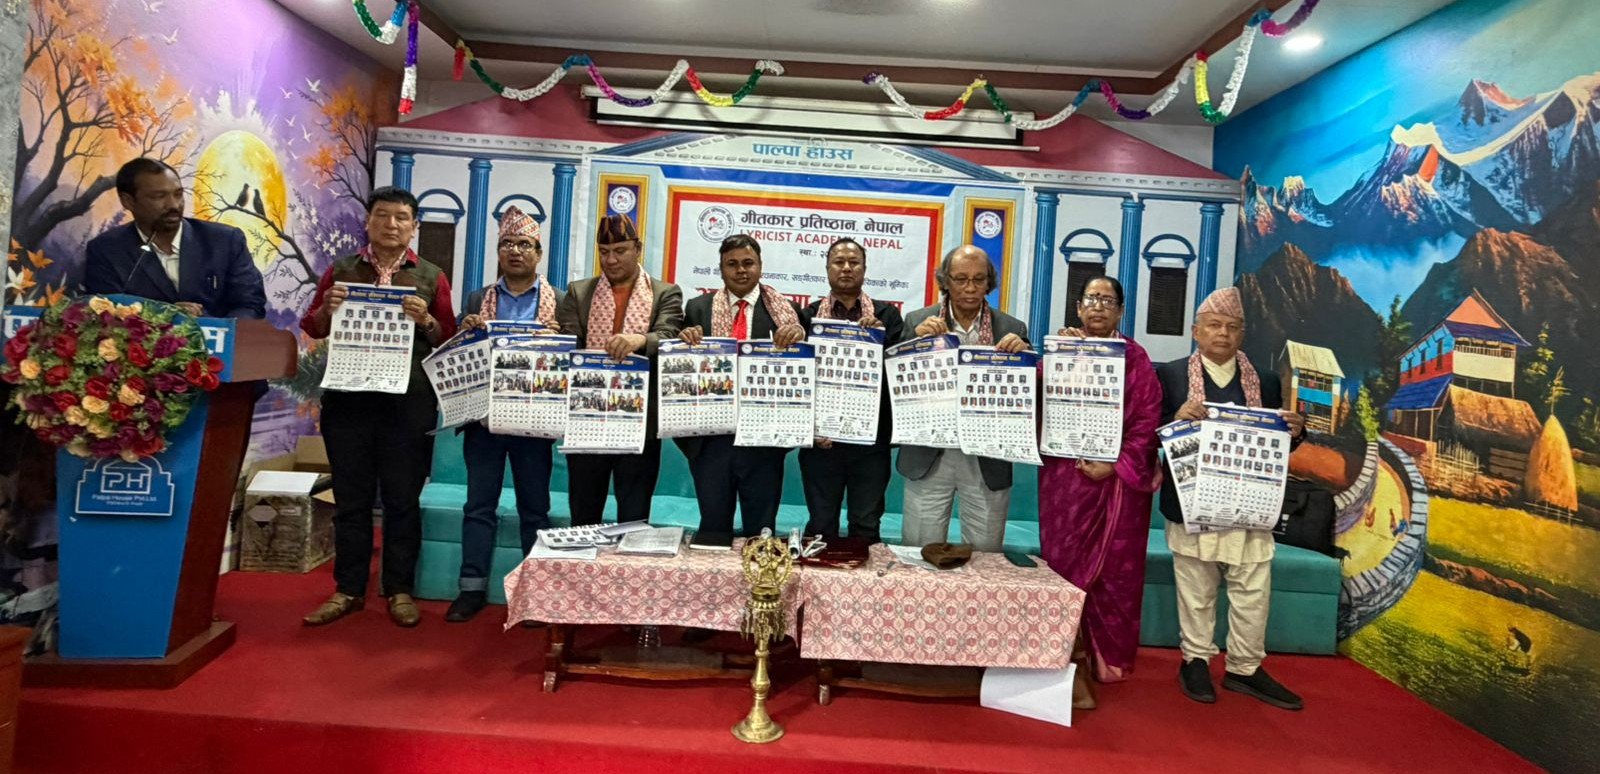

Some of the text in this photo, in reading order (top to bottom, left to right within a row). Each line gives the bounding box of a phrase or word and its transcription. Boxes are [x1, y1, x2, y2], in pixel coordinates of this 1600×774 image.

[752, 143, 854, 160] पाल्पा हाउस
[741, 210, 796, 228] गीतकार
[864, 217, 904, 235] नेपाल
[863, 237, 903, 250] NEPAL
